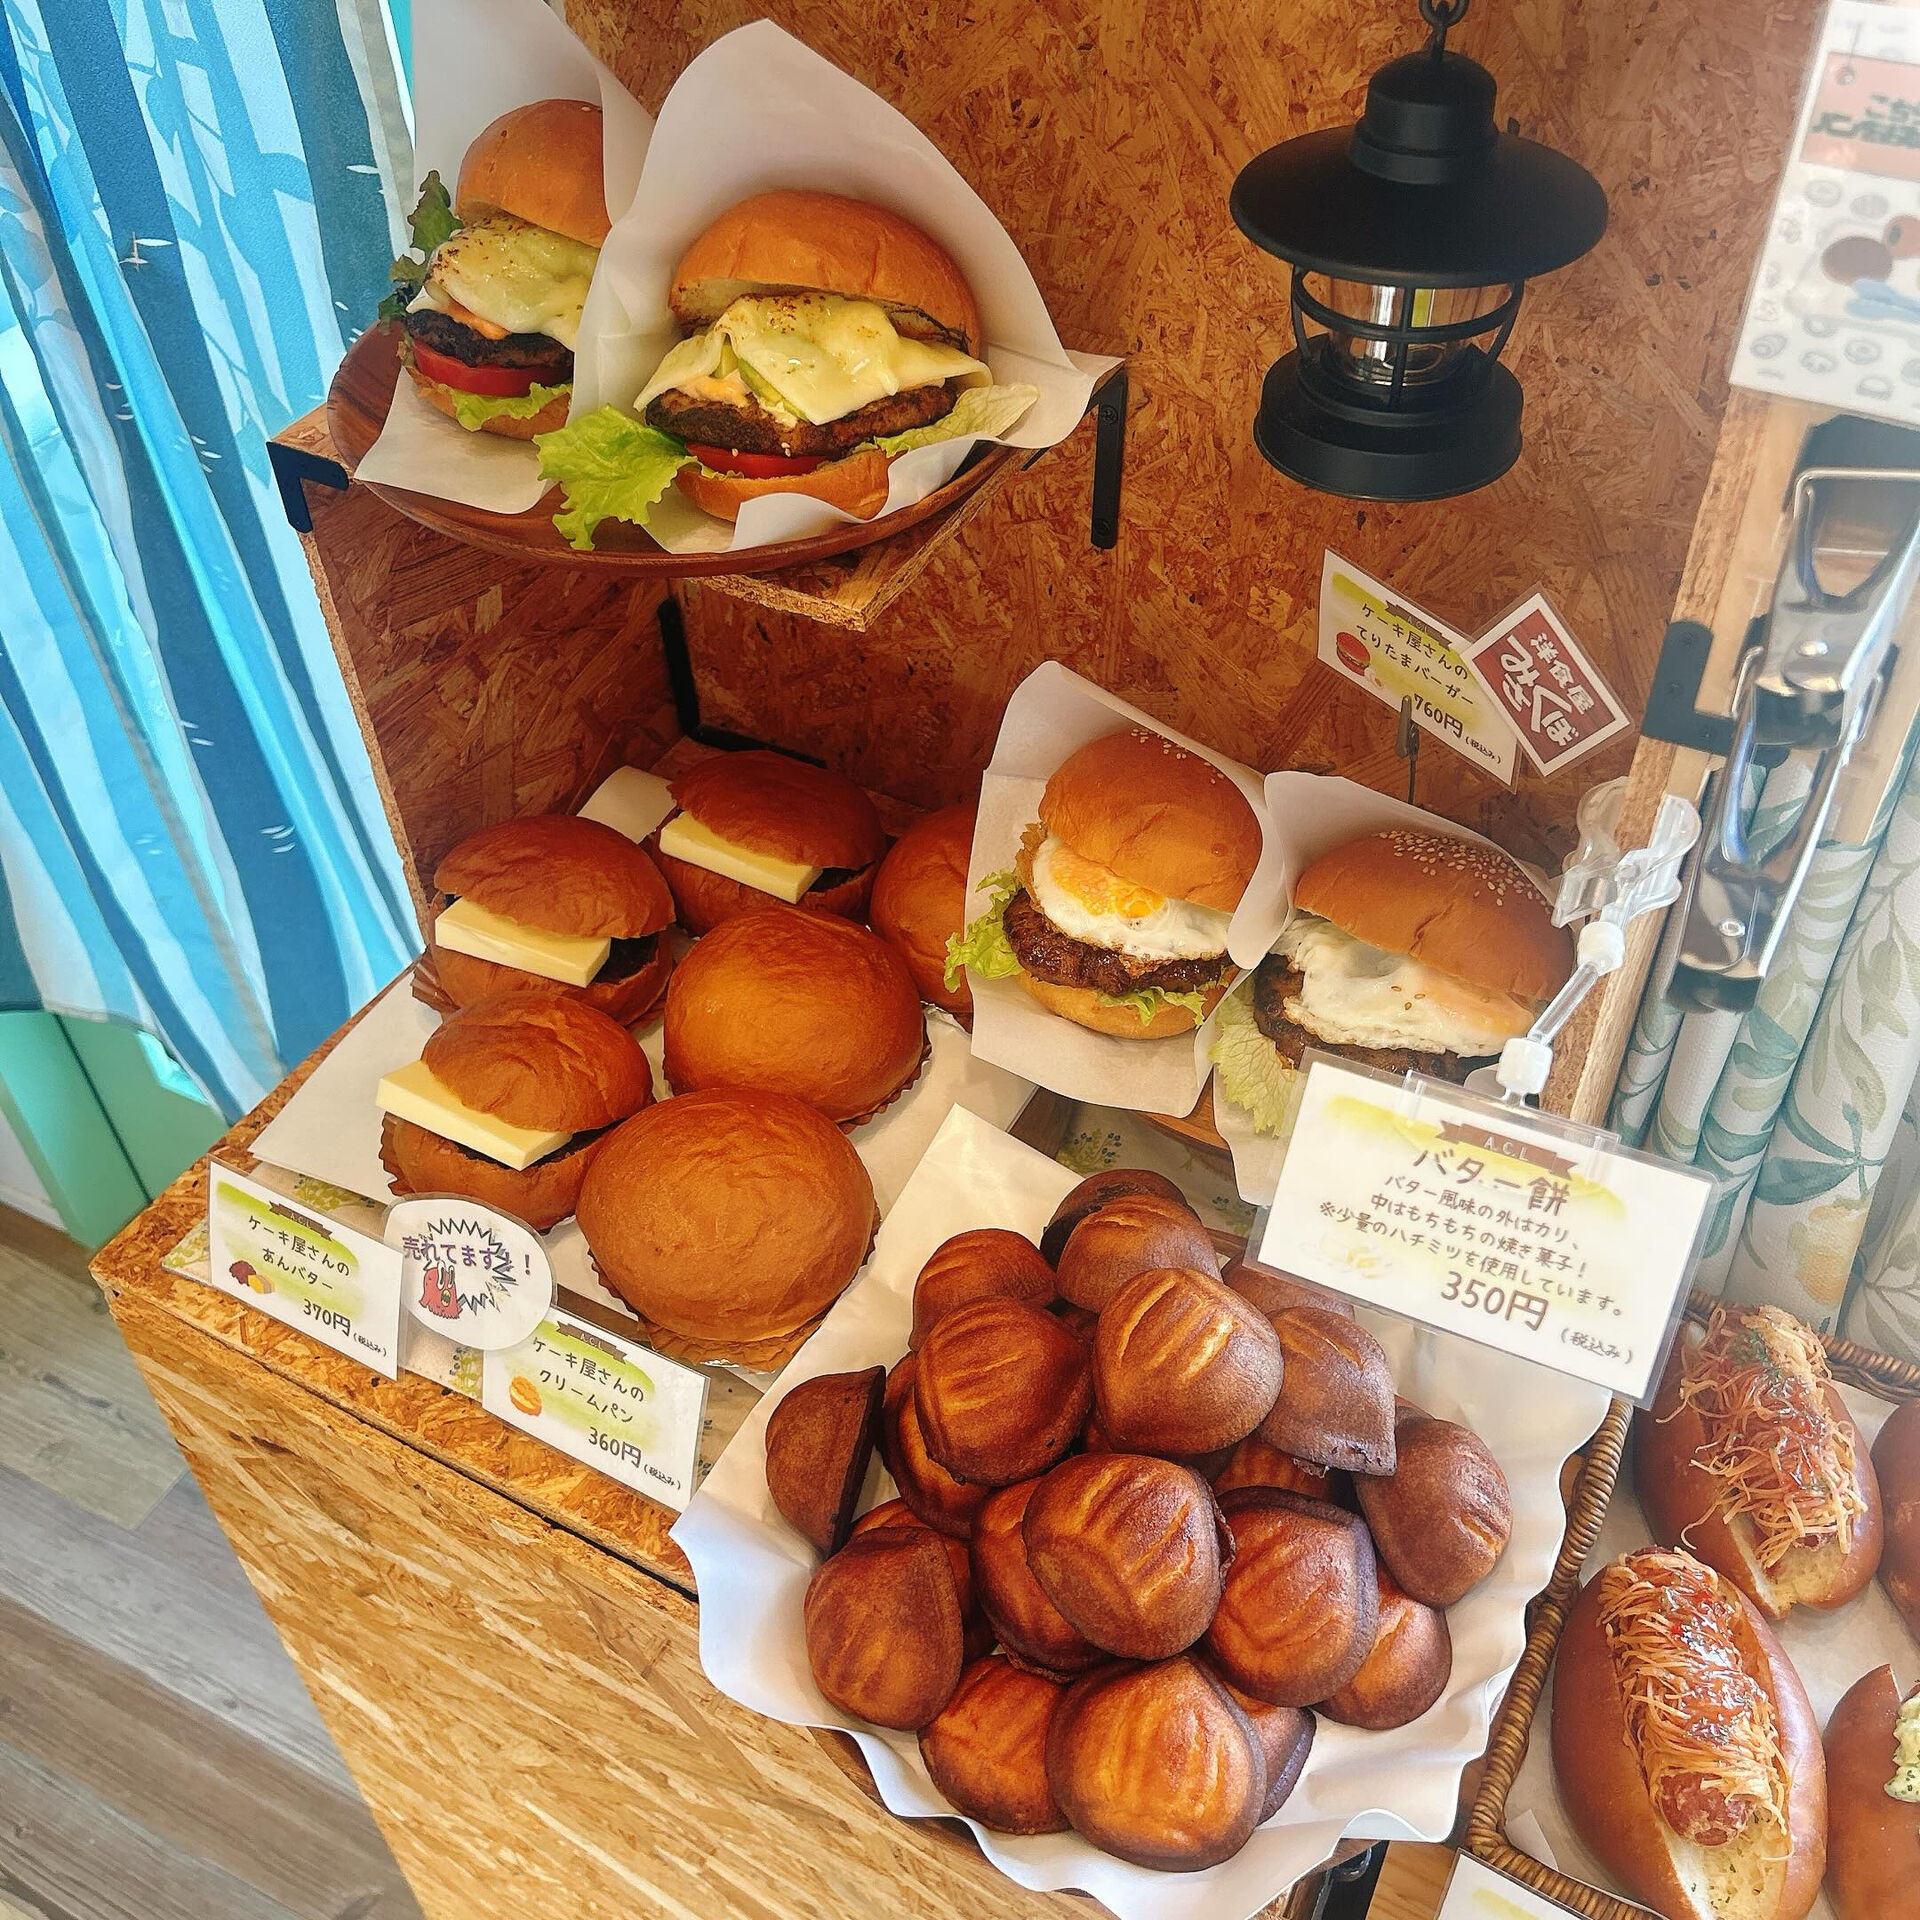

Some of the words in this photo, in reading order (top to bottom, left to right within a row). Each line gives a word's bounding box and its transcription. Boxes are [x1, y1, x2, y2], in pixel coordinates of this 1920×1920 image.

[1356, 624, 1474, 705] てりたまバーガー
[1361, 603, 1468, 680] ケーキ屋さんの
[1530, 632, 1595, 715] 洋食屋
[1413, 693, 1464, 739] 760円
[1500, 634, 1579, 746] みさくぼ
[1385, 1175, 1579, 1250] バター風味の外はカリ、
[1413, 1148, 1571, 1217] バター餅
[248, 1214, 351, 1278] ケーキ屋さんの
[1370, 1192, 1587, 1278] 中はもちもちの焼き菓子！
[262, 1247, 334, 1292] あんバター
[1440, 1270, 1550, 1332] 350円
[303, 1297, 352, 1338] 370円
[532, 1336, 645, 1403] ケーキ屋さんの
[539, 1368, 634, 1424] クリームパン
[587, 1426, 642, 1469] 360円
